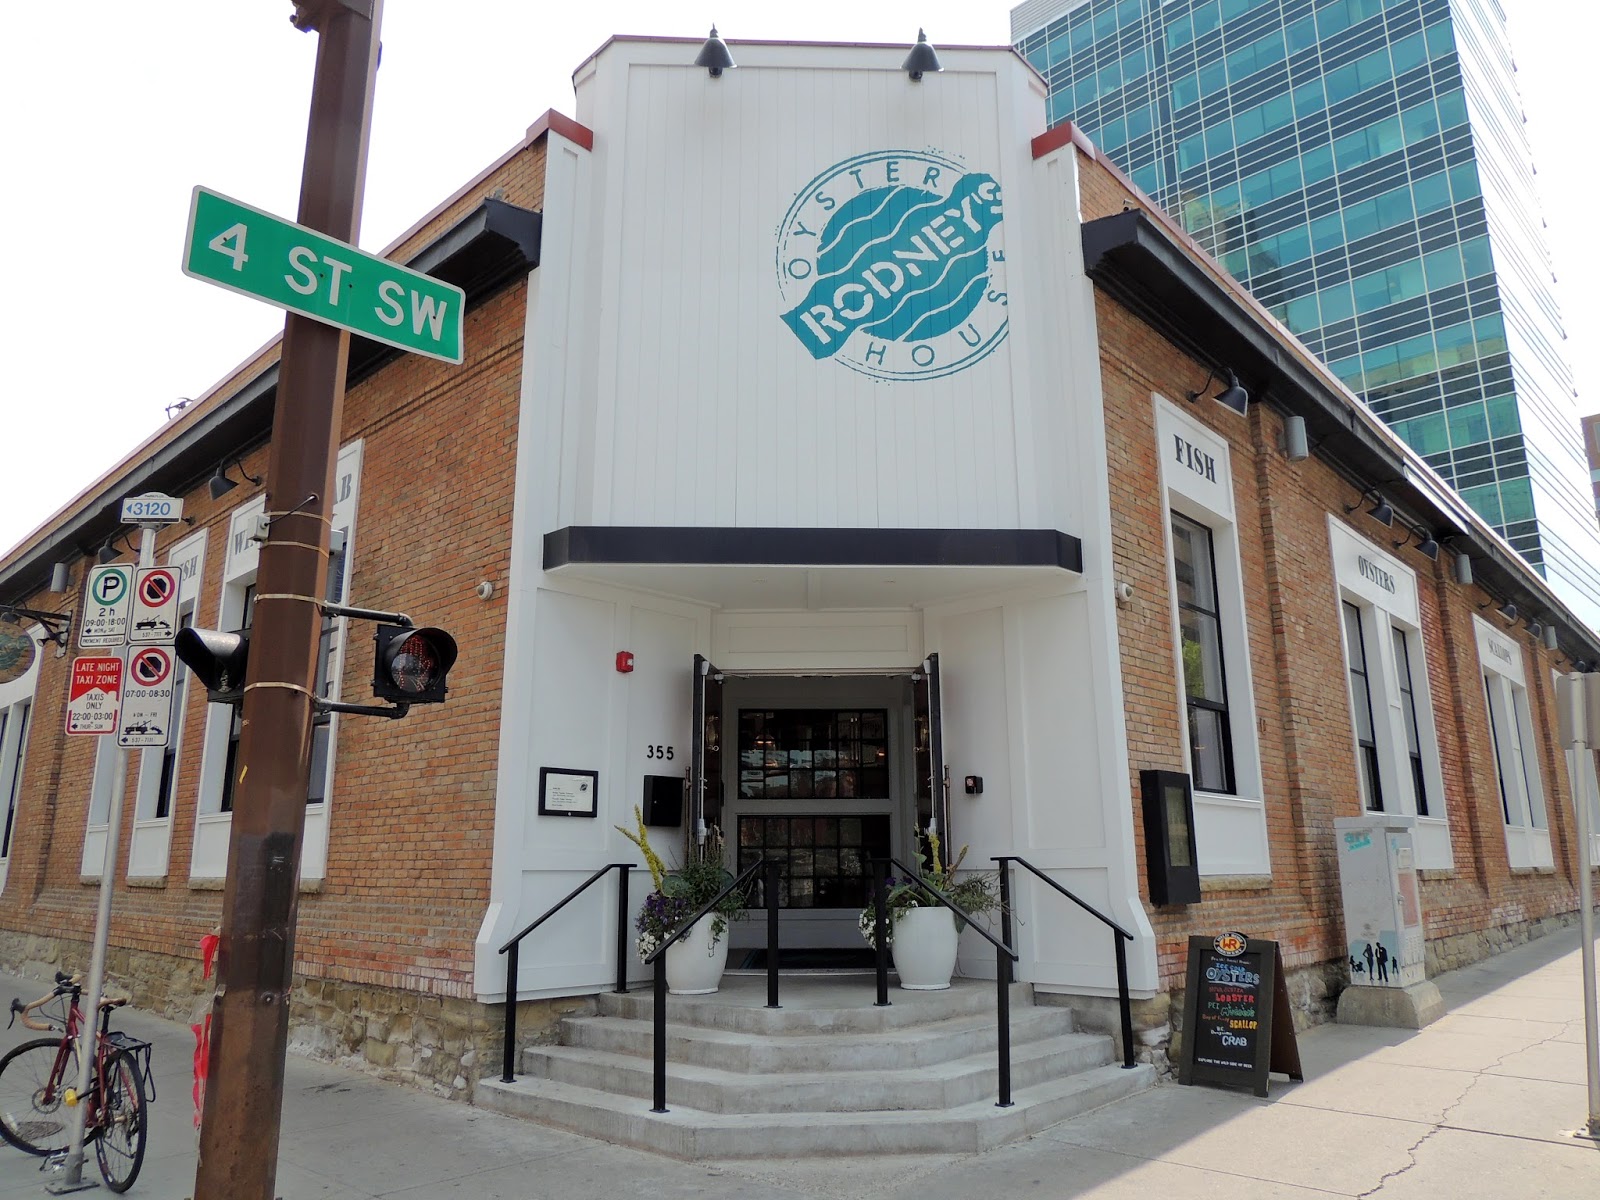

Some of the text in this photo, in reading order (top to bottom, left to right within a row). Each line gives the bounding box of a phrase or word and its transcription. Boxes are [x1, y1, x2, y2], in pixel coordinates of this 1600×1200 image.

[788, 161, 940, 280] OYSTER
[208, 223, 447, 341] 4 ST SW
[865, 249, 1008, 366] HOUSE
[1173, 433, 1216, 484] FISH
[133, 502, 171, 515] 3120
[1358, 555, 1395, 594] OYSTERS
[102, 576, 120, 598] P
[99, 607, 115, 616] 2 h
[76, 662, 119, 671] LATE NIGHT
[76, 675, 117, 684] TAXI ZONE
[86, 693, 104, 701] TAXIS
[126, 689, 170, 698] 07:00-08:30
[86, 702, 102, 710] ONLY
[647, 745, 674, 760] 355
[1222, 938, 1237, 949] WR
[1206, 967, 1260, 985] OYSTERS
[1215, 993, 1254, 1003] LOBSTER
[1230, 1020, 1258, 1030] SCALLOP
[1222, 1035, 1247, 1046] CRAB
